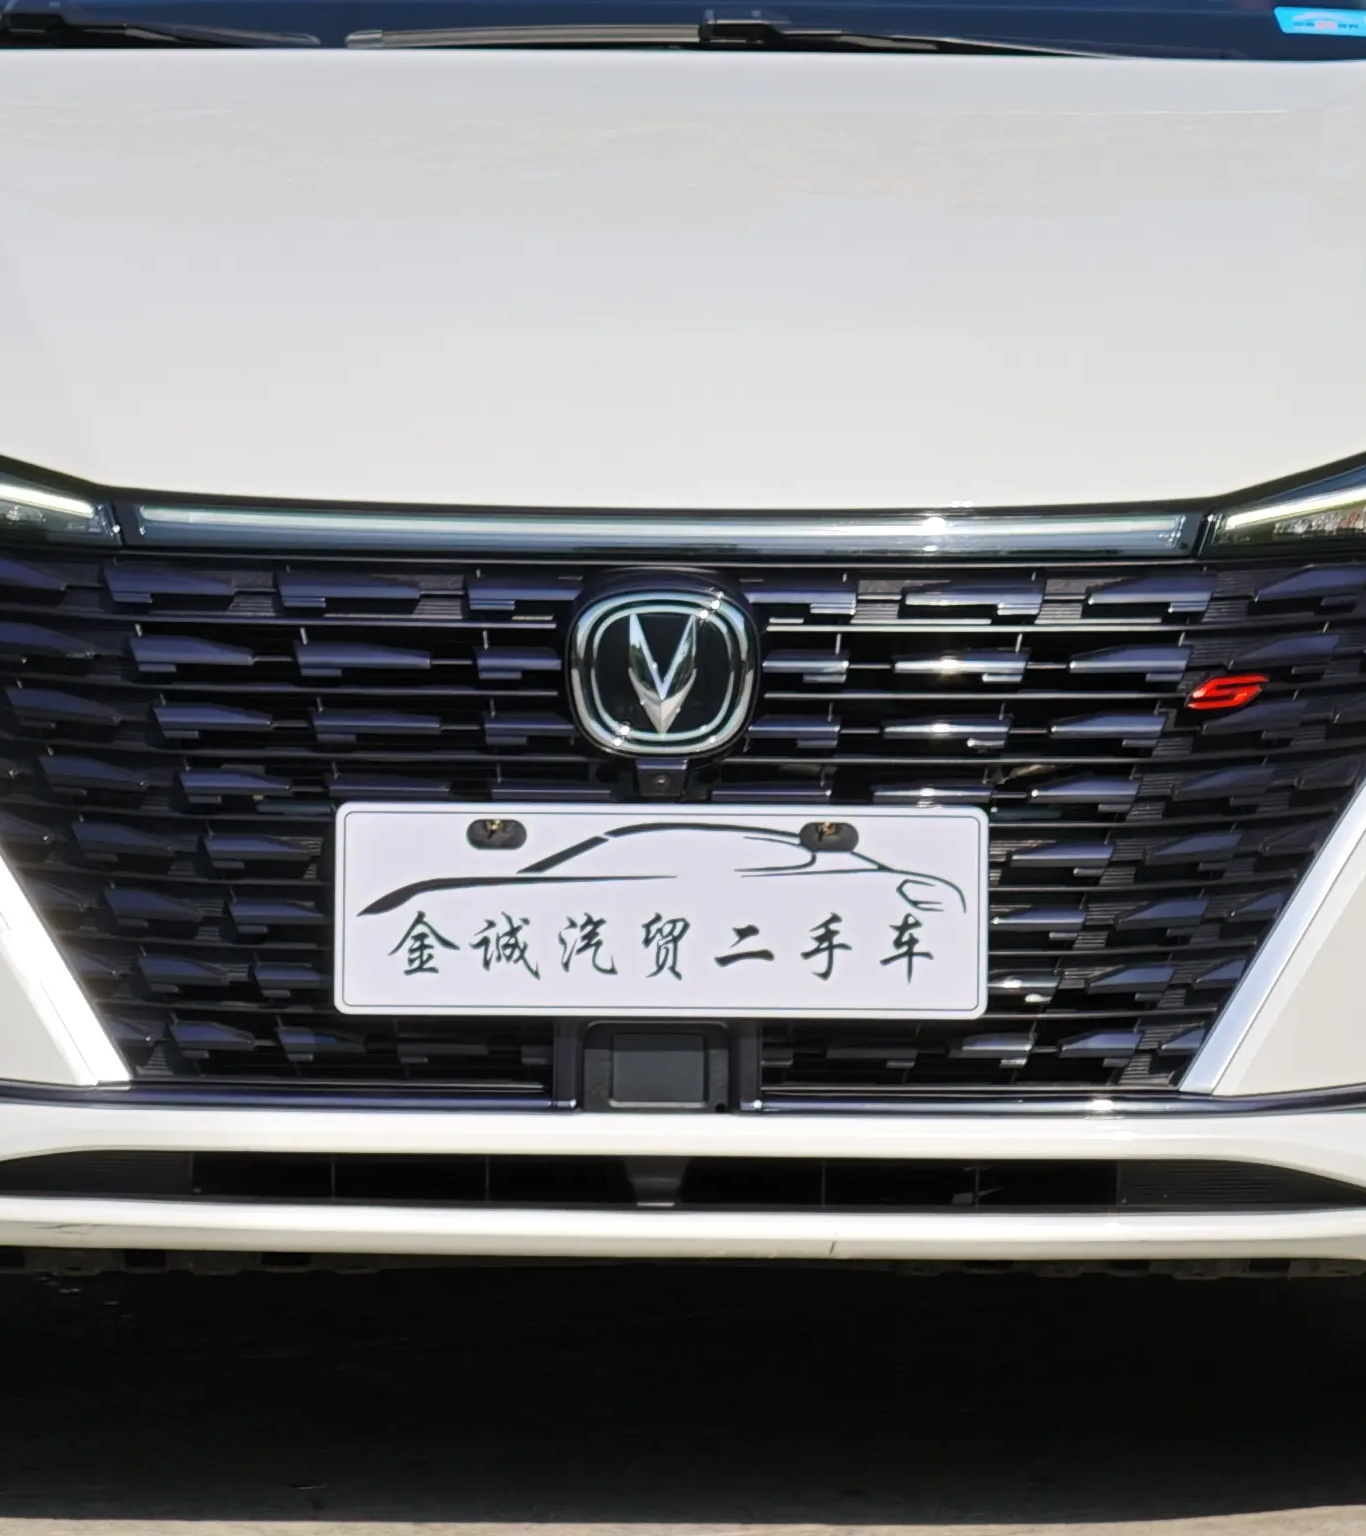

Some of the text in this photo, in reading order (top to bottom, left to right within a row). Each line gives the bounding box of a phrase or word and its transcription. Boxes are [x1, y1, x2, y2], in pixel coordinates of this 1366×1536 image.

[388, 910, 935, 985] 金诚汽贸二手车
